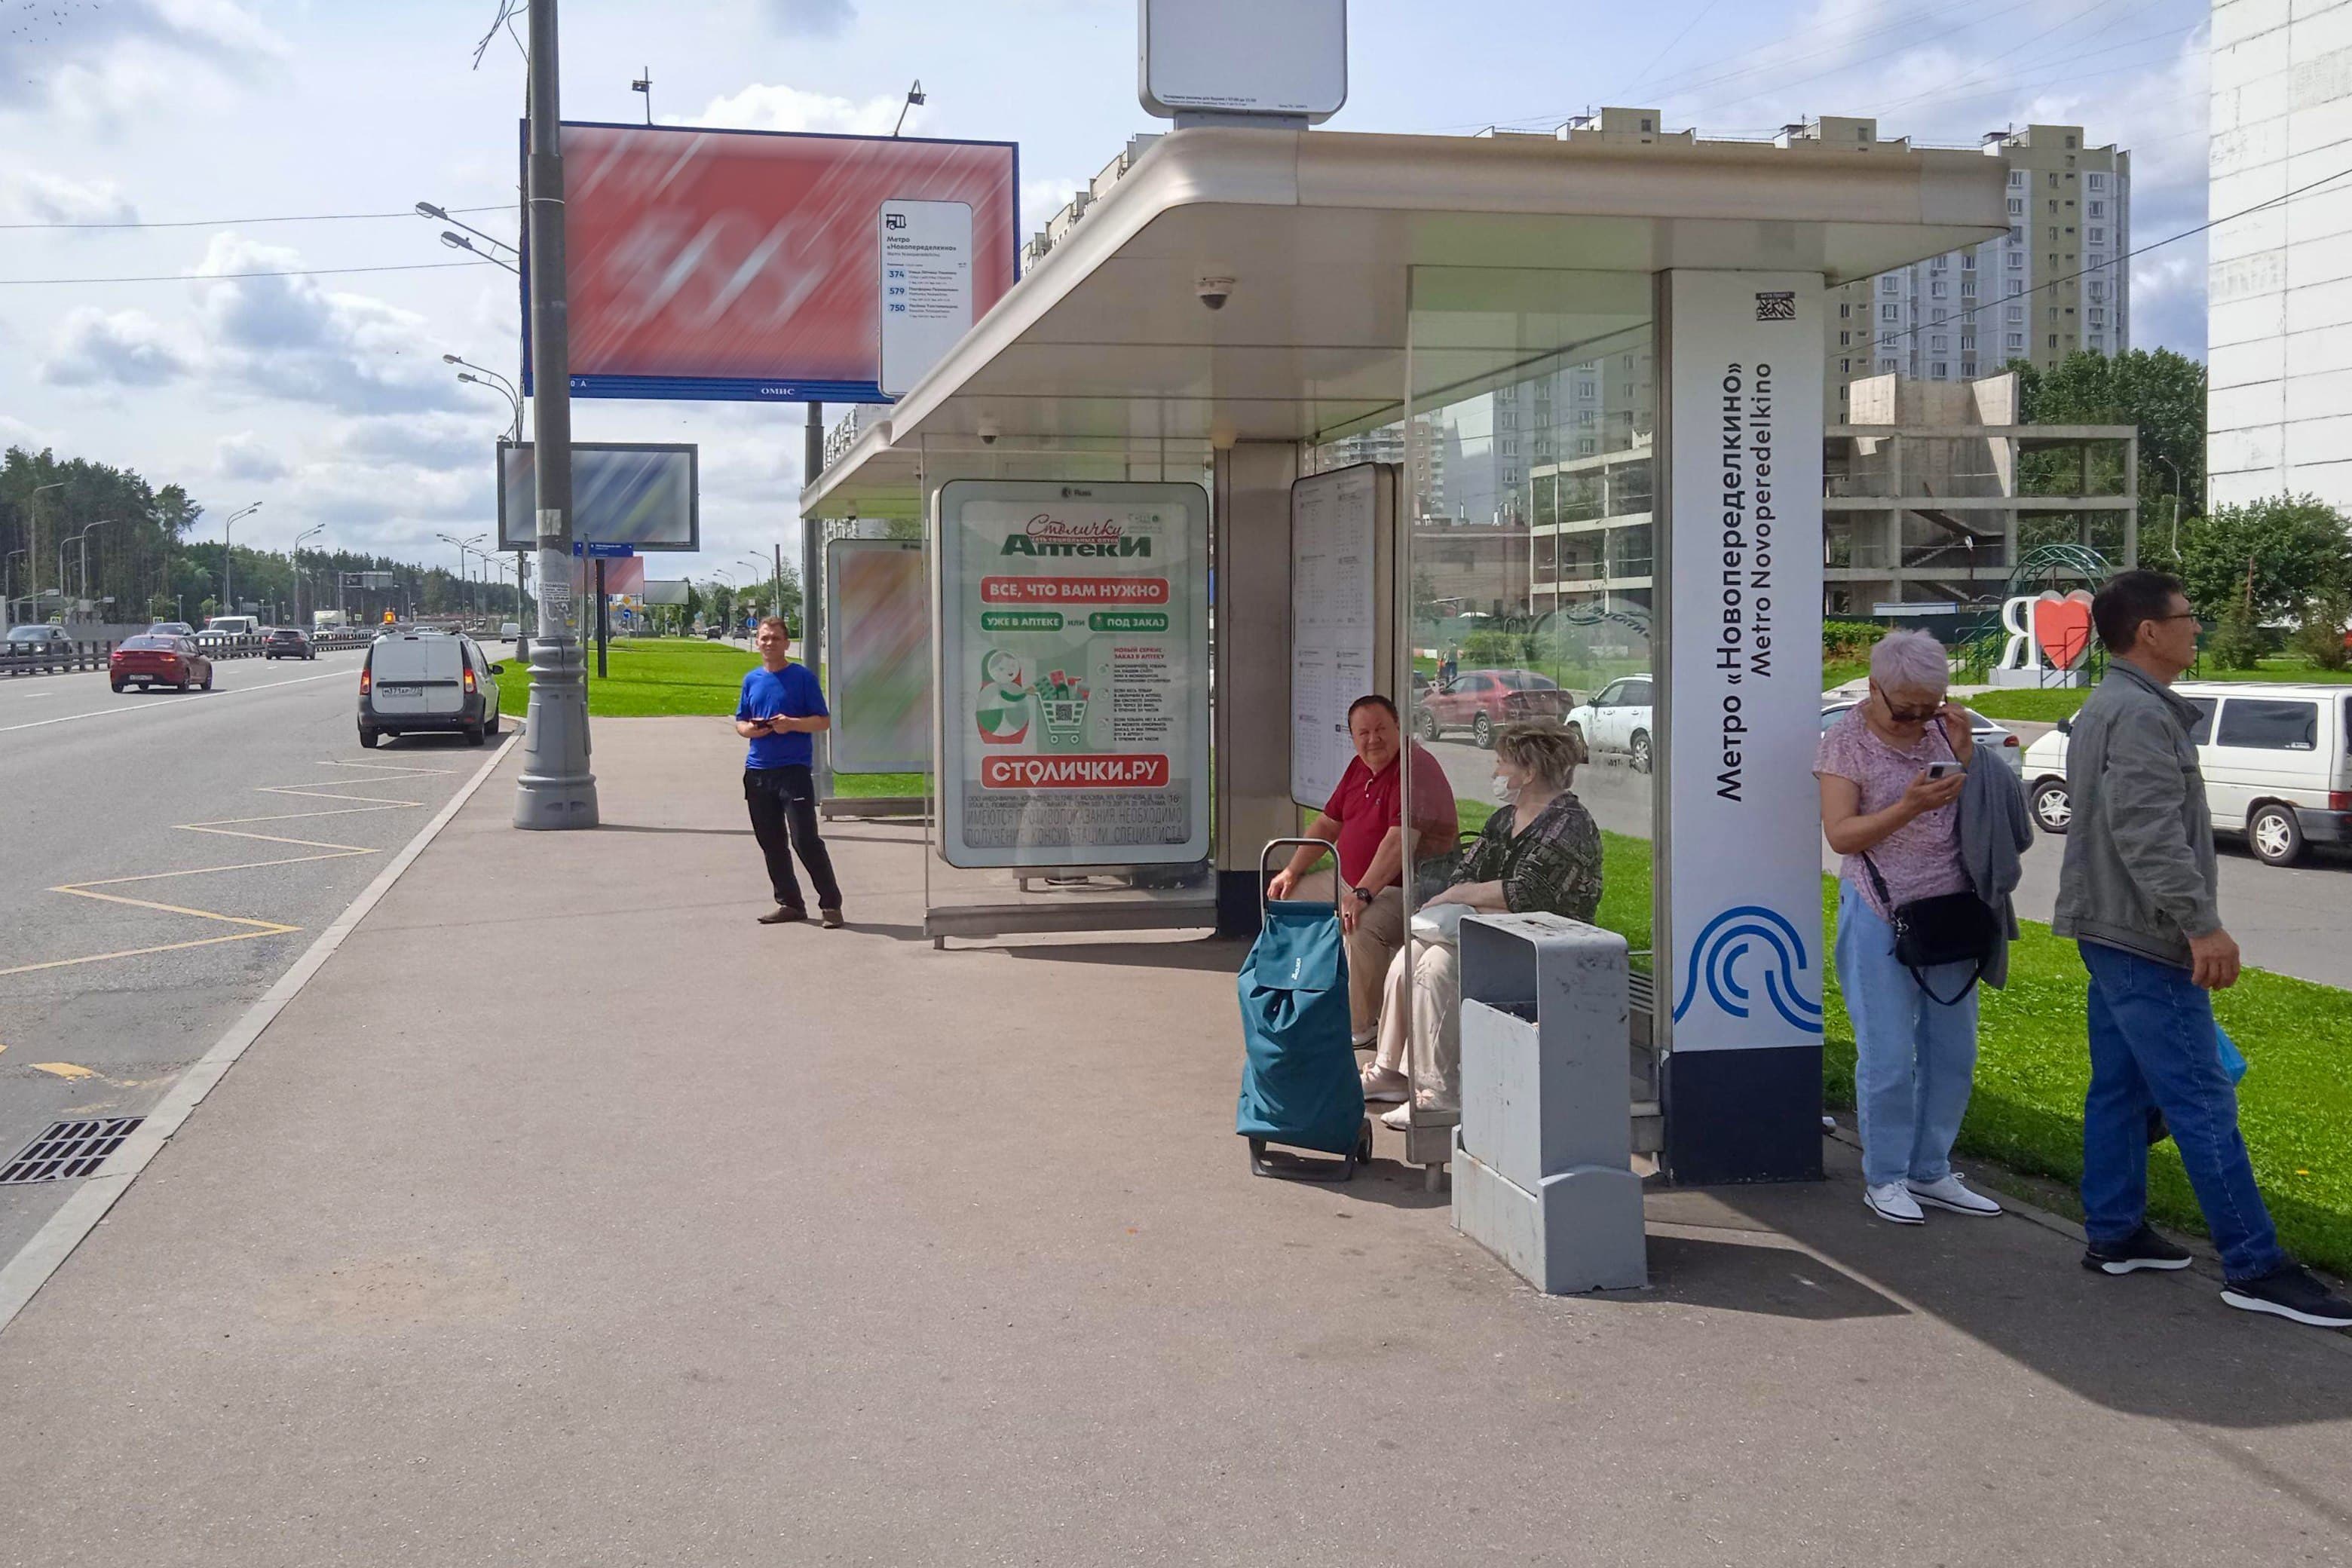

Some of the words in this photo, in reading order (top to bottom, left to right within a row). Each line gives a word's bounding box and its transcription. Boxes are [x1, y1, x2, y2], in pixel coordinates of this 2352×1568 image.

[890, 304, 906, 312] 750
[1749, 363, 1776, 589] Novoperedelkino
[1026, 513, 1125, 536] Столички
[1716, 363, 1747, 685] «Новопеределкино»
[990, 583, 1022, 598] ВСЕ,
[1026, 583, 1057, 596] ЧТО
[1061, 584, 1096, 597] ВАМ
[1100, 585, 1160, 597] НУЖНО
[987, 617, 1009, 626] УЖЕ
[1012, 617, 1018, 626] В
[1021, 617, 1059, 626] АПТЕКЕ
[1107, 618, 1130, 628] ПОД
[1132, 618, 1165, 627] ЗАКАЗ
[1996, 596, 2045, 670] Я
[1750, 597, 1772, 678] Metro
[1717, 695, 1748, 803] Метро
[991, 760, 1159, 786] СТОЛИЧКИ.РУ
[967, 807, 1013, 826] ИМЕЮТСЯ
[1119, 807, 1182, 825] НЕОБХОДИМО
[967, 828, 1026, 845] ПОЛУЧЕНИЕ
[1114, 825, 1182, 844] СПЕЦИАЛИСТА
